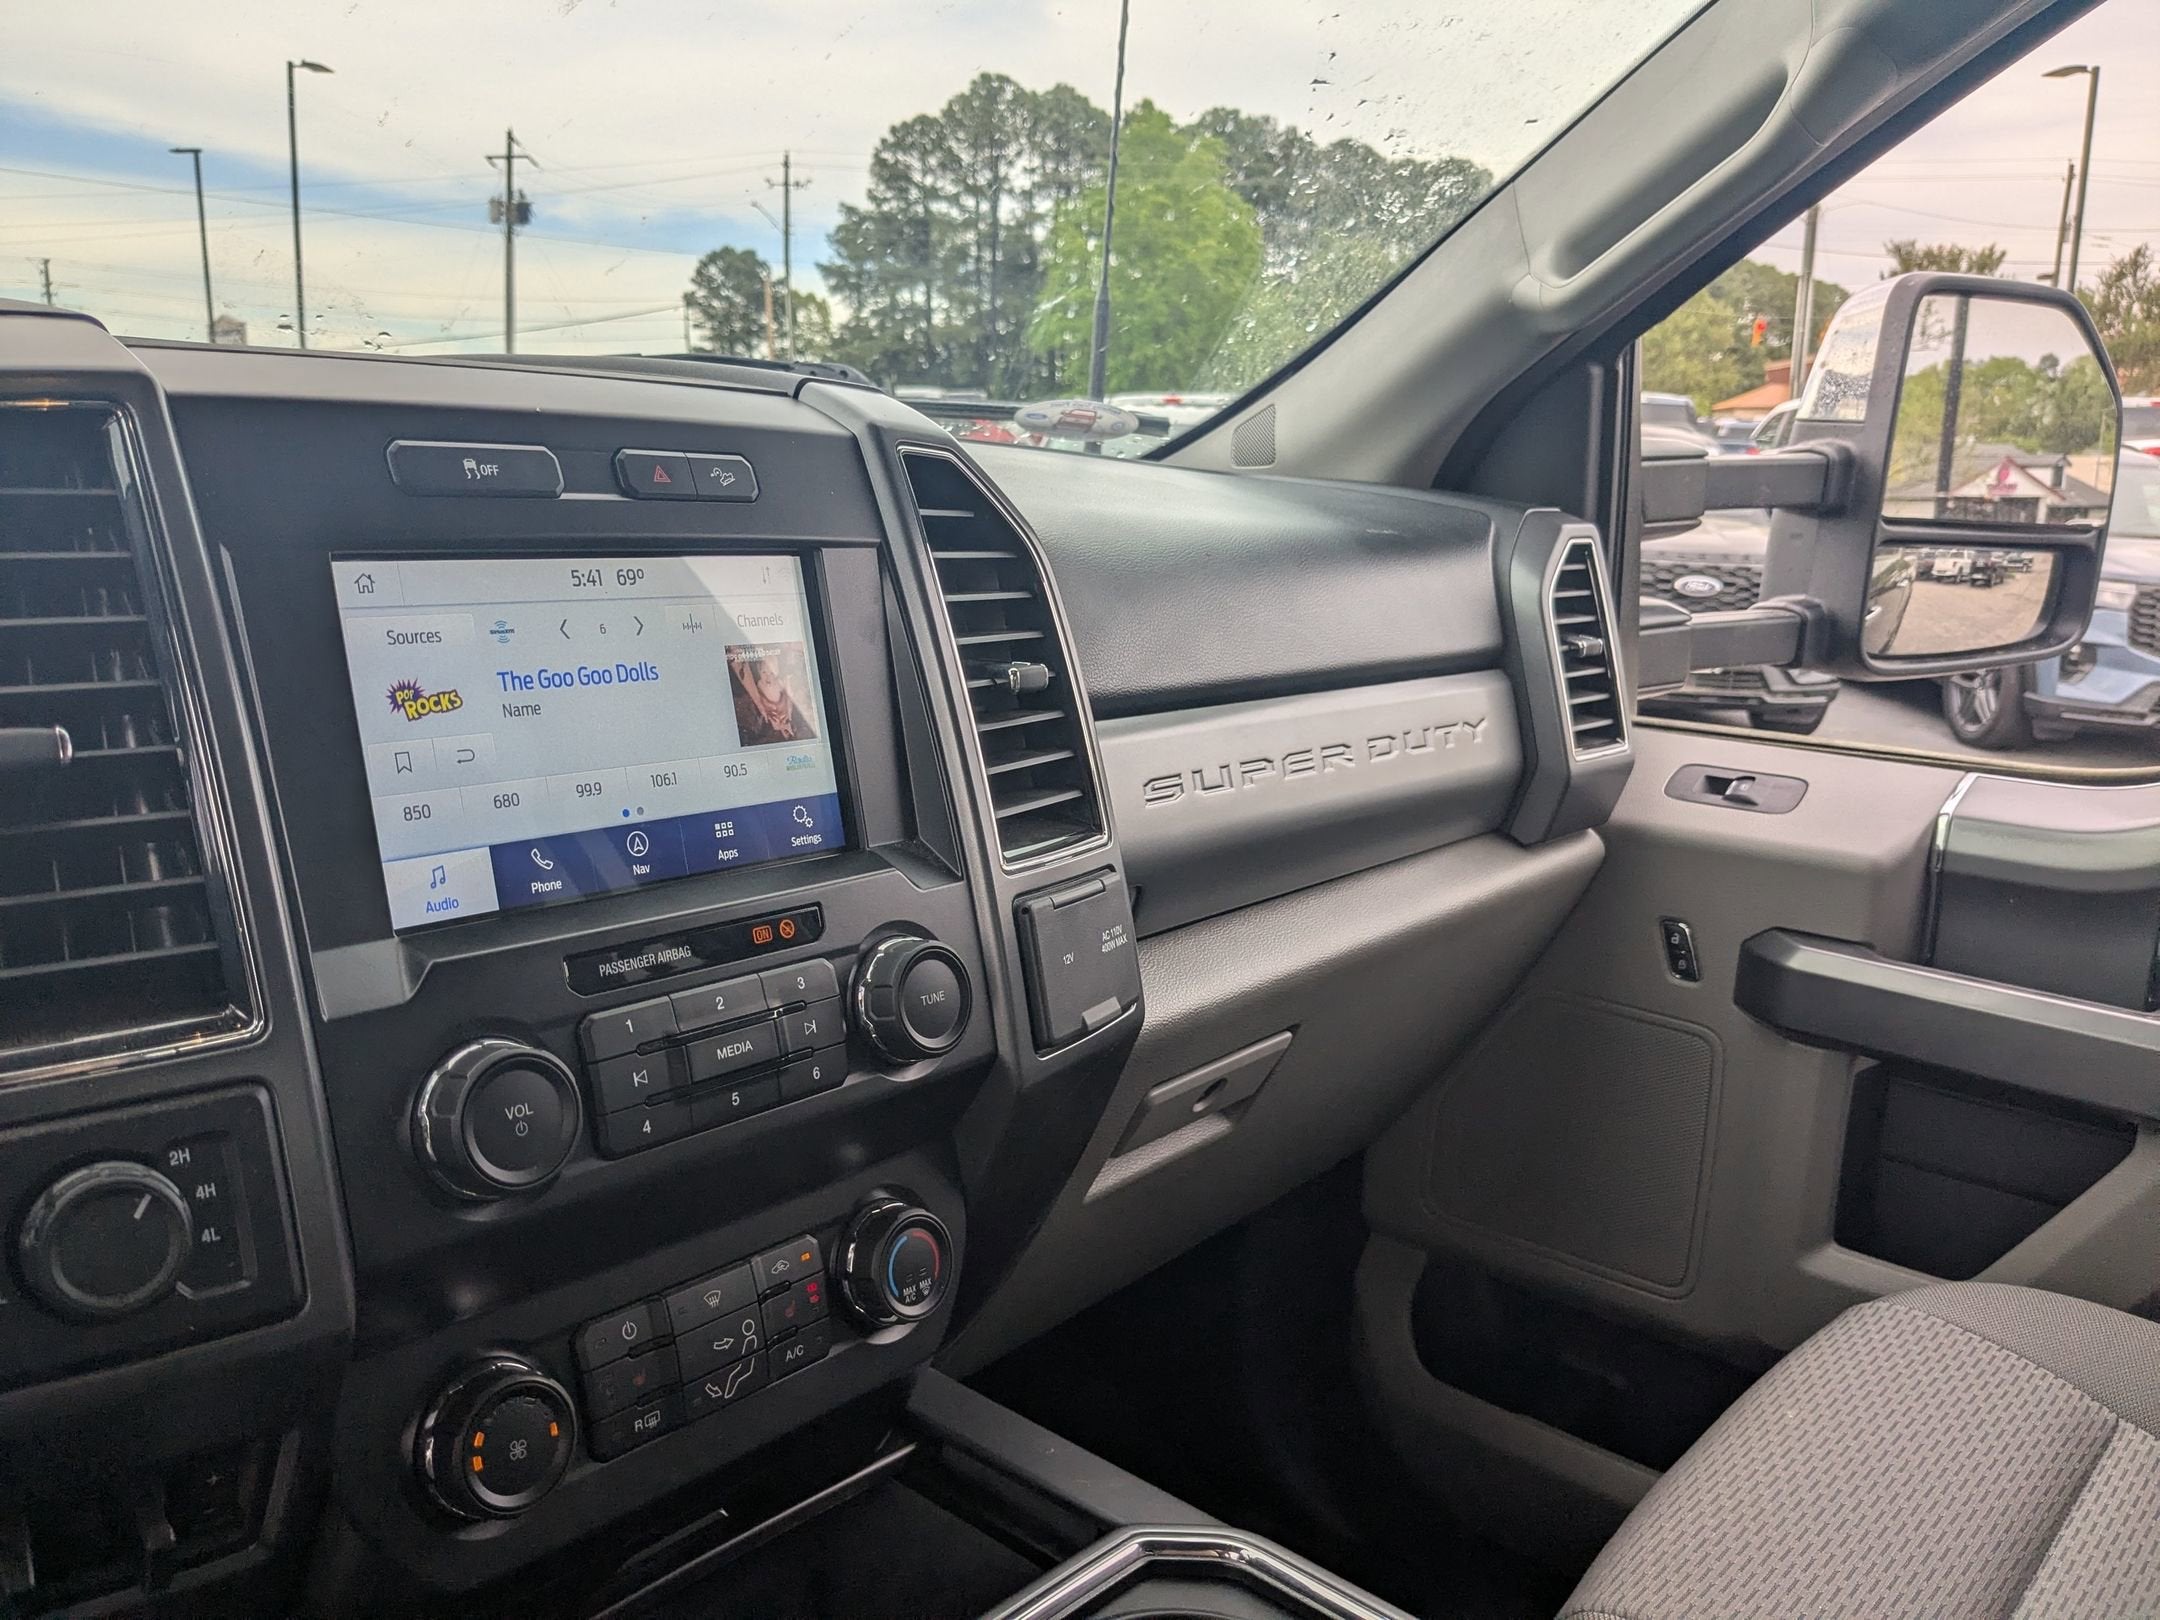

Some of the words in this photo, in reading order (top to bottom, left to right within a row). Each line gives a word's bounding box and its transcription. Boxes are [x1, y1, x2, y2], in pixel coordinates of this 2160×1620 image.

[480, 465, 499, 476] OFF
[571, 569, 602, 588] 5:41
[737, 613, 784, 628] Channels
[600, 624, 606, 635] 6
[387, 629, 442, 646] Sources
[497, 671, 534, 692] The
[538, 668, 574, 689] Goo
[578, 665, 613, 688] Goo
[617, 661, 659, 684] Dolls
[404, 691, 462, 720] ROCKS
[502, 702, 541, 718] Name
[723, 763, 748, 778] 90.5
[1143, 742, 1355, 808] SUPER
[1367, 718, 1486, 763] DUTY
[650, 771, 678, 788] 106.1
[576, 782, 602, 798] 99.9
[493, 793, 520, 808] 680
[403, 804, 431, 821] 850
[791, 833, 822, 848] Settings
[718, 847, 739, 861] Apps
[633, 864, 650, 876] Nav
[531, 879, 562, 894] Phone
[426, 897, 459, 913] Audio
[757, 929, 769, 940] ON
[1102, 930, 1110, 942] AC
[1115, 933, 1128, 948] MAX
[599, 956, 656, 977] PASSENGER
[658, 945, 691, 963] AIRBAG
[1063, 952, 1074, 965] 12V
[797, 976, 805, 990] 3
[715, 996, 725, 1010] 2
[920, 990, 945, 1006] TUNE
[625, 1019, 634, 1033] 1
[716, 1040, 753, 1060] MEDIA
[812, 1066, 821, 1080] 6
[732, 1092, 740, 1106] 5
[504, 1102, 533, 1119] VOL
[642, 1119, 651, 1134] 4
[169, 1148, 190, 1165] 2H
[195, 1182, 216, 1198] 4H
[201, 1227, 220, 1243] 4L
[903, 1285, 916, 1297] MAX
[919, 1277, 931, 1290] MAX
[785, 1345, 804, 1362] A/C
